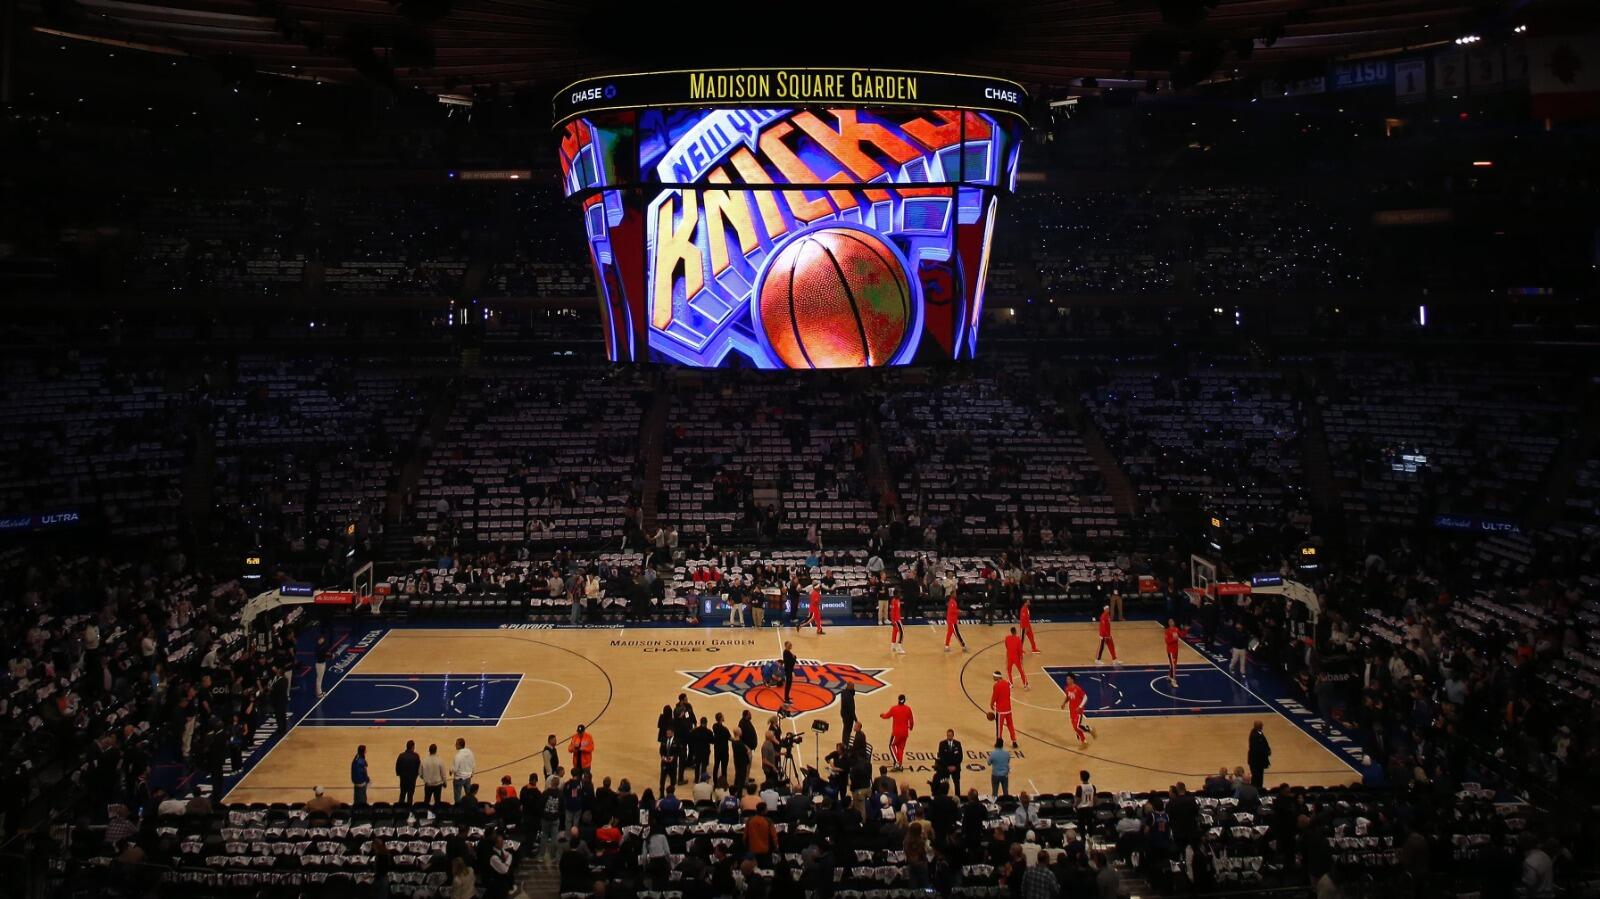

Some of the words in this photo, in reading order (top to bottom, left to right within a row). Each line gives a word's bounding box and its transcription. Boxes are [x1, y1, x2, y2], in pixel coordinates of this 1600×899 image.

[689, 74, 771, 99] MADISON
[776, 70, 845, 100] SQUARE
[848, 70, 918, 101] GARDEN
[571, 87, 603, 105] CHASE
[984, 86, 1018, 105] CHASE
[41, 513, 79, 524] ULTRA
[665, 639, 708, 647] SQUARE
[688, 663, 887, 691] KNCKS
[1274, 698, 1314, 715] NEW
[966, 750, 1025, 760] GAEN
